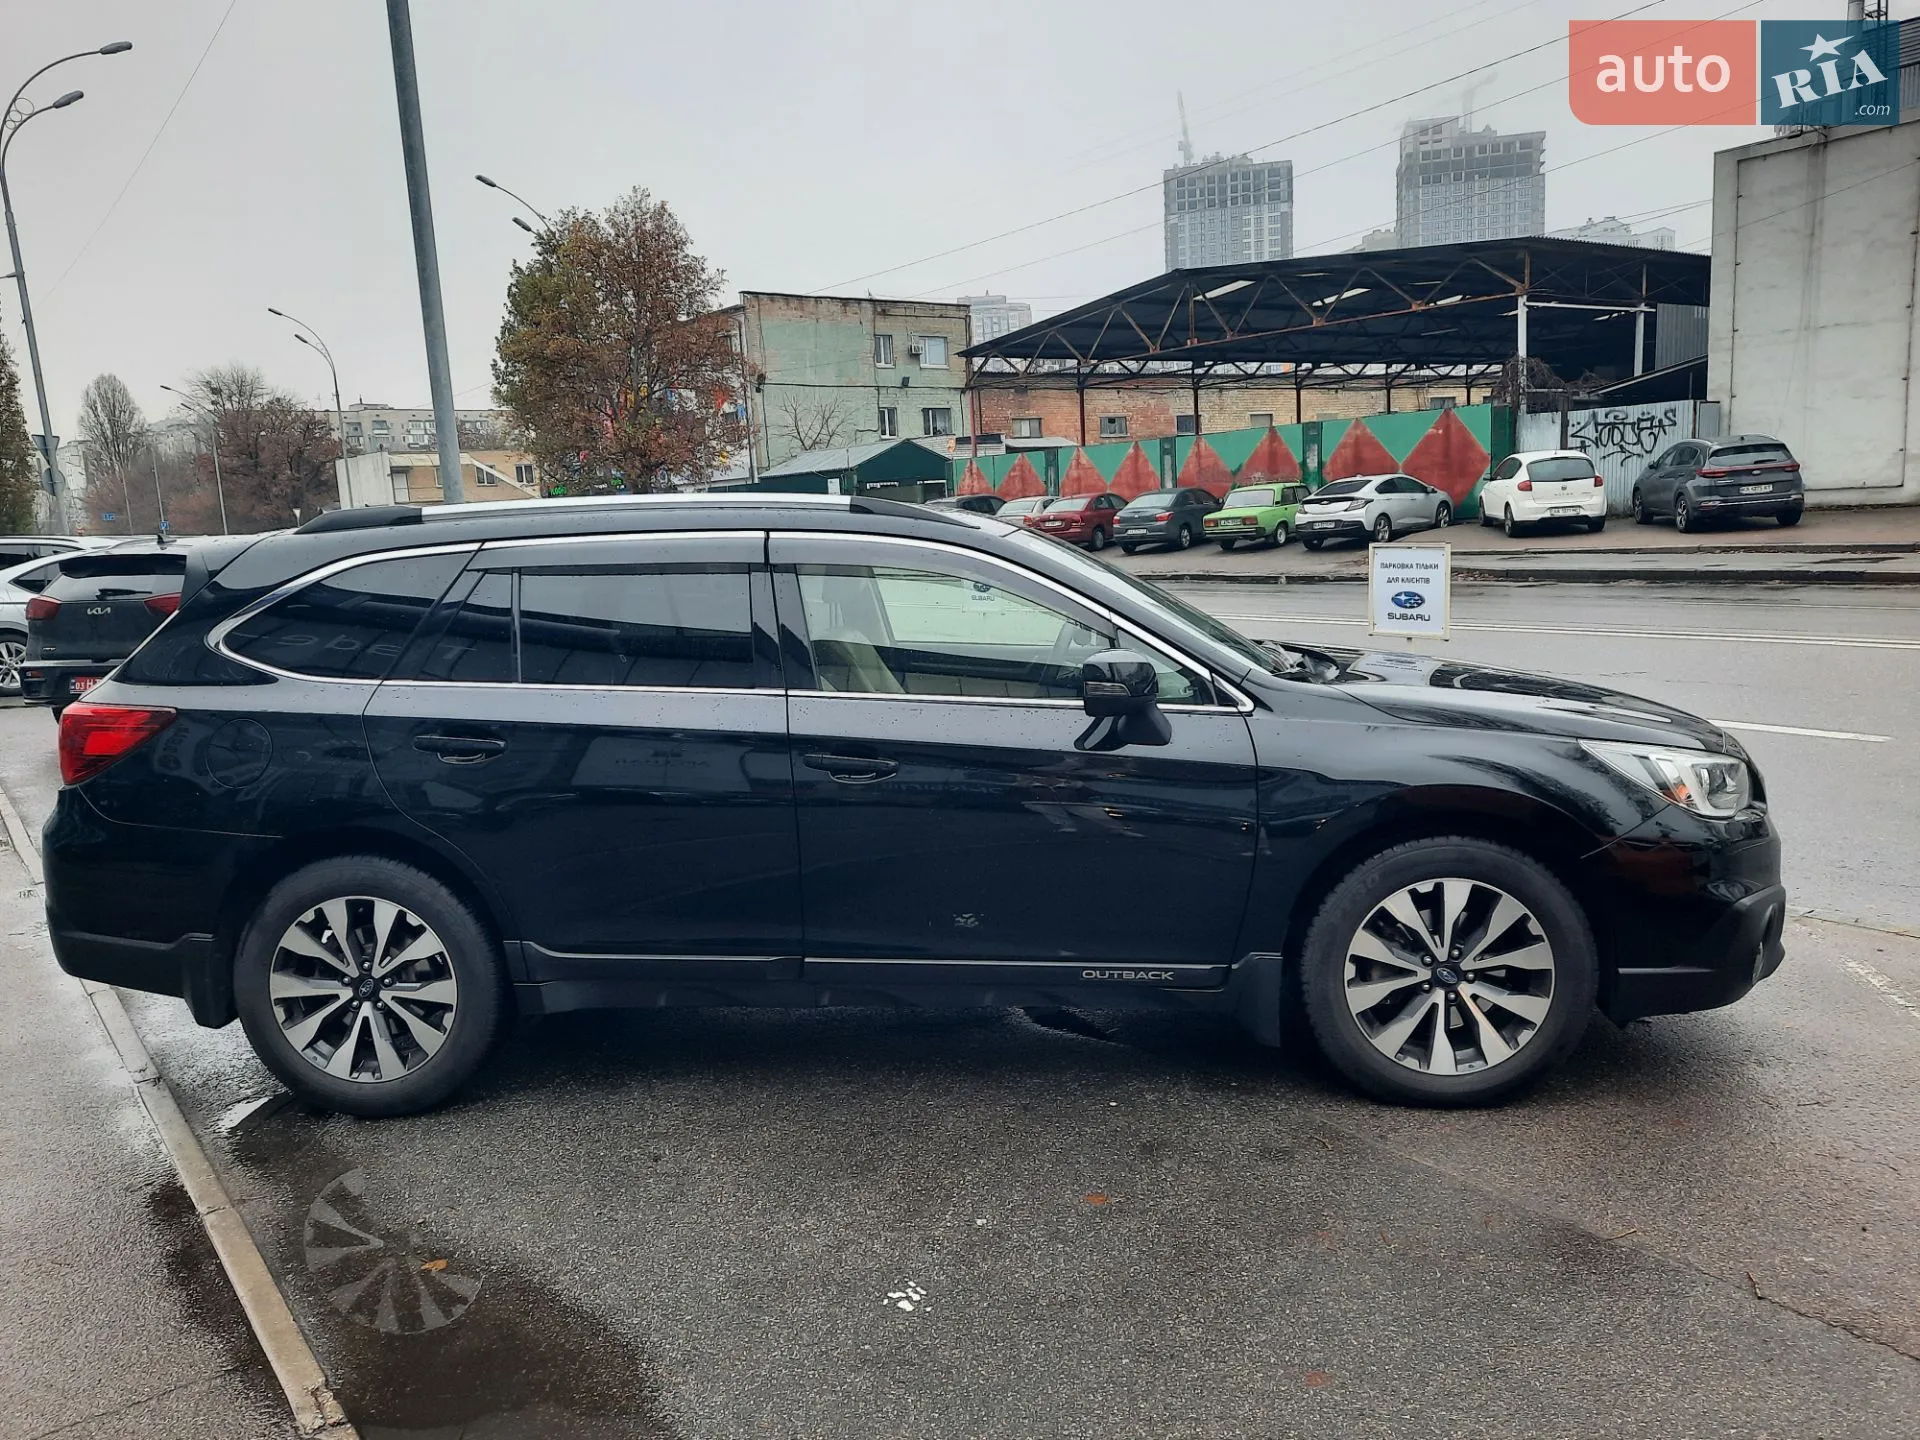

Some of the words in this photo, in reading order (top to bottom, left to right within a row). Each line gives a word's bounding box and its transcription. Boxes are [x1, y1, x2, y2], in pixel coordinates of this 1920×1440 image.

[1386, 576, 1400, 584] ДЛЯ
[1387, 612, 1431, 621] SUBARU
[1082, 970, 1175, 980] OUTBACK
